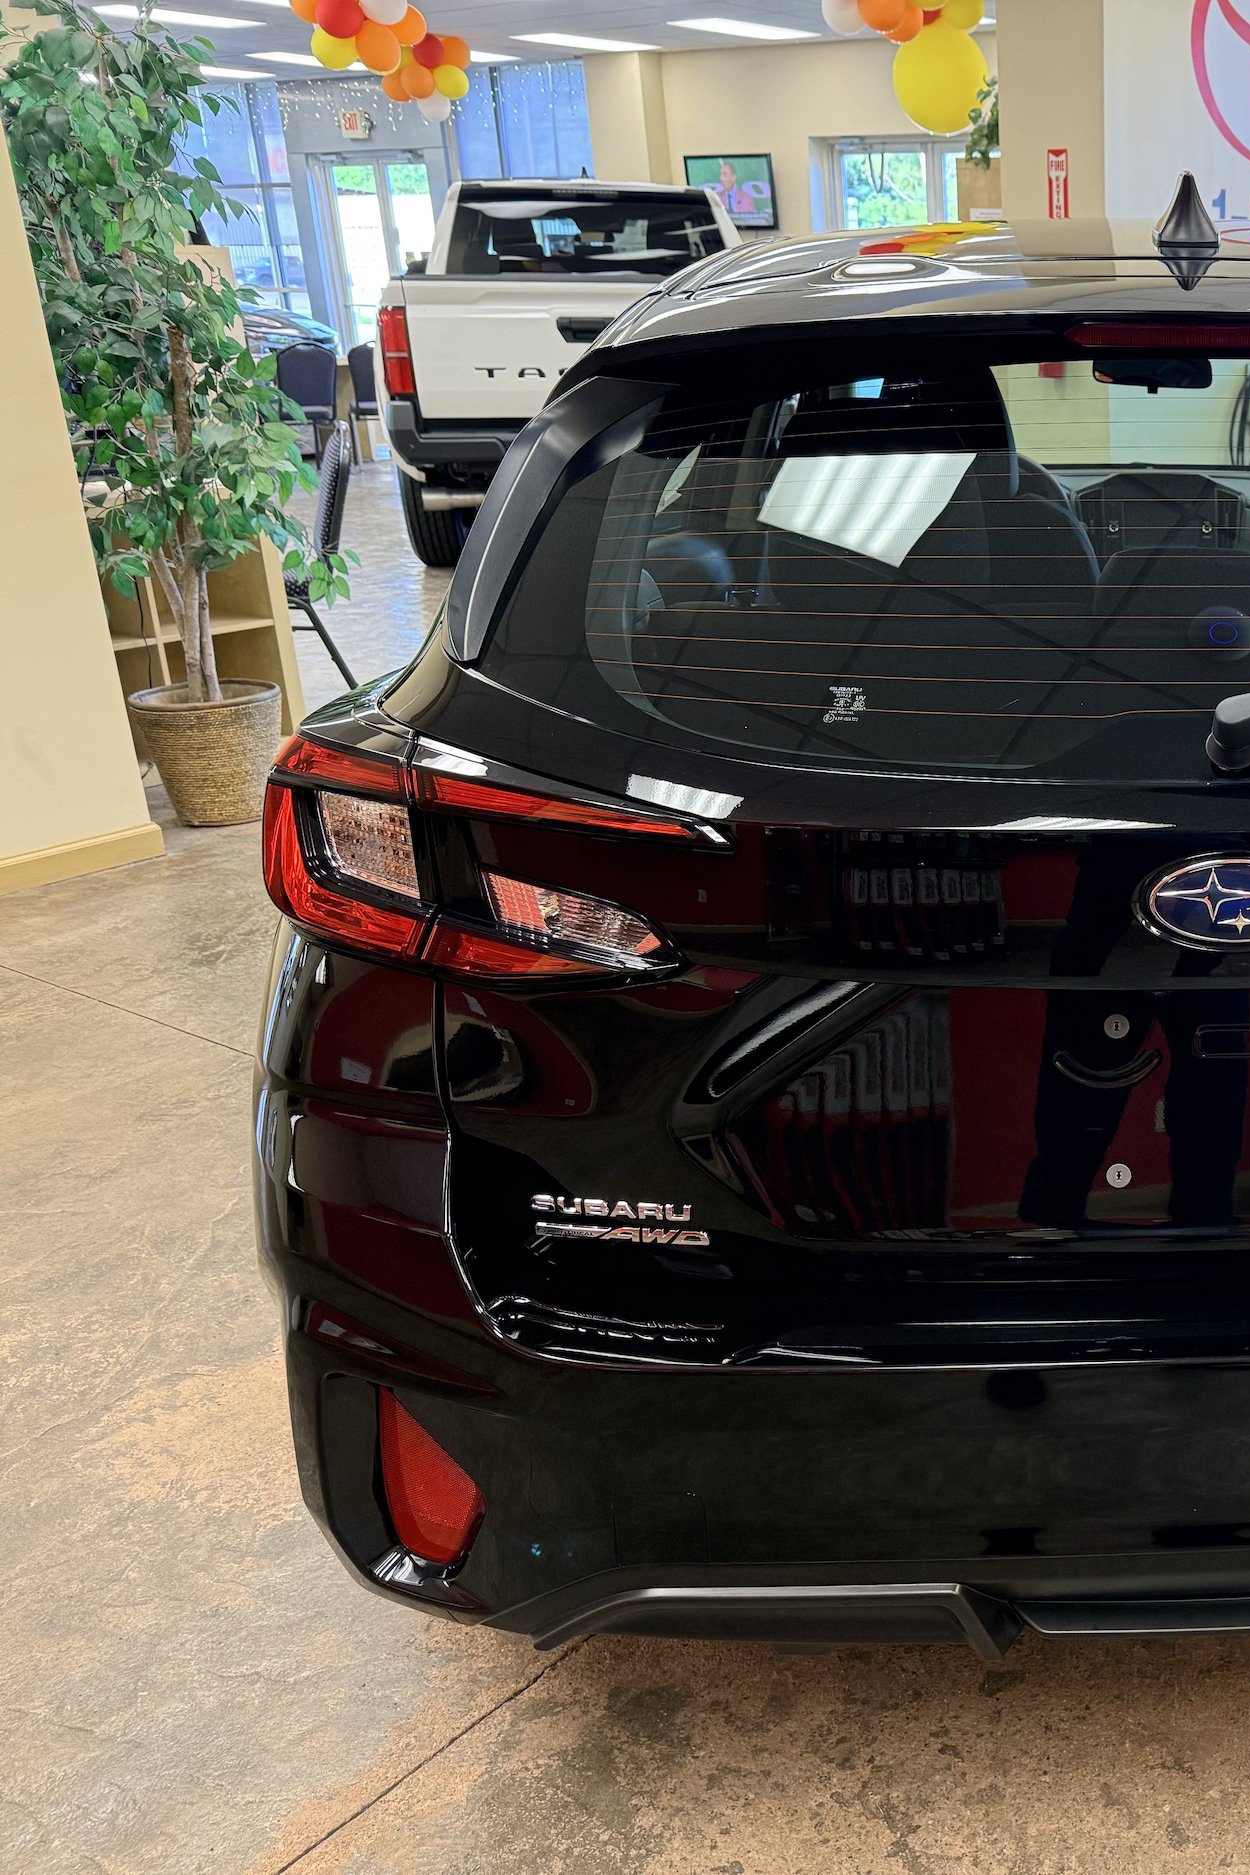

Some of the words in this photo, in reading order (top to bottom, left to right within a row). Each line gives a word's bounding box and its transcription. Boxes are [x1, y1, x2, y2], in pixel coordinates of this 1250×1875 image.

[342, 112, 358, 131] EXIT
[1050, 160, 1065, 172] FIRE
[530, 1194, 692, 1222] SUBARU
[599, 1227, 710, 1246] AWD
